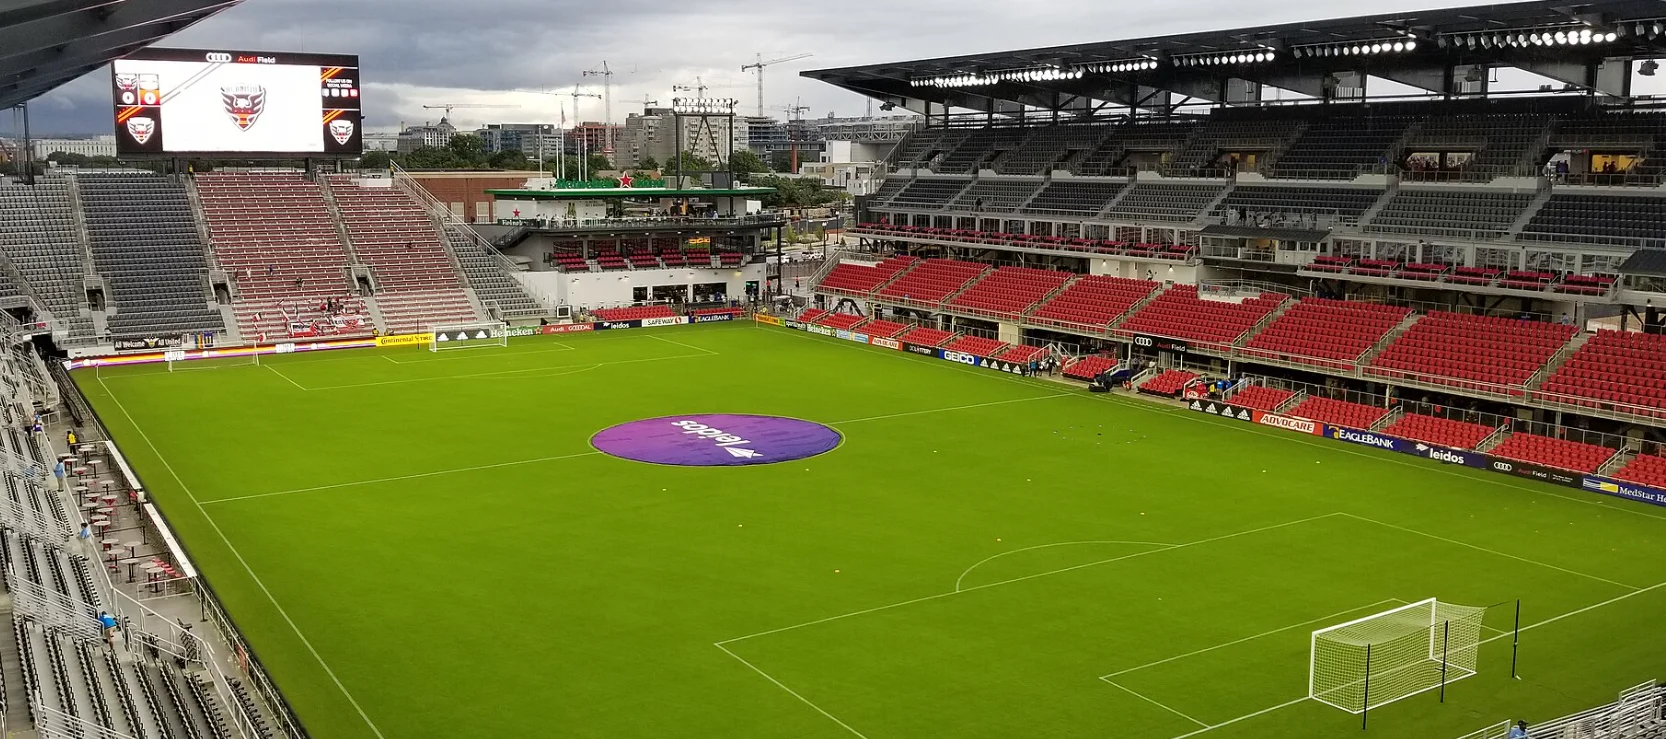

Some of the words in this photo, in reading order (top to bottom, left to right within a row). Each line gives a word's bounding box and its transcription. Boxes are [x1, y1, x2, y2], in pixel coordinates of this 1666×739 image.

[490, 328, 533, 338] Heineken
[114, 341, 122, 349] All
[123, 340, 145, 348] Welcome
[165, 338, 181, 346] United
[381, 336, 414, 344] Continental
[1157, 342, 1171, 350] Audi
[1171, 343, 1186, 351] Field
[944, 350, 975, 365] GEICO
[1261, 414, 1315, 433] ADVOCARE
[671, 420, 751, 446] leidos
[1339, 429, 1394, 449] EAGLEBANK
[1429, 447, 1465, 464] leidos
[1532, 470, 1547, 478] Field
[1619, 486, 1655, 501] MedStar
